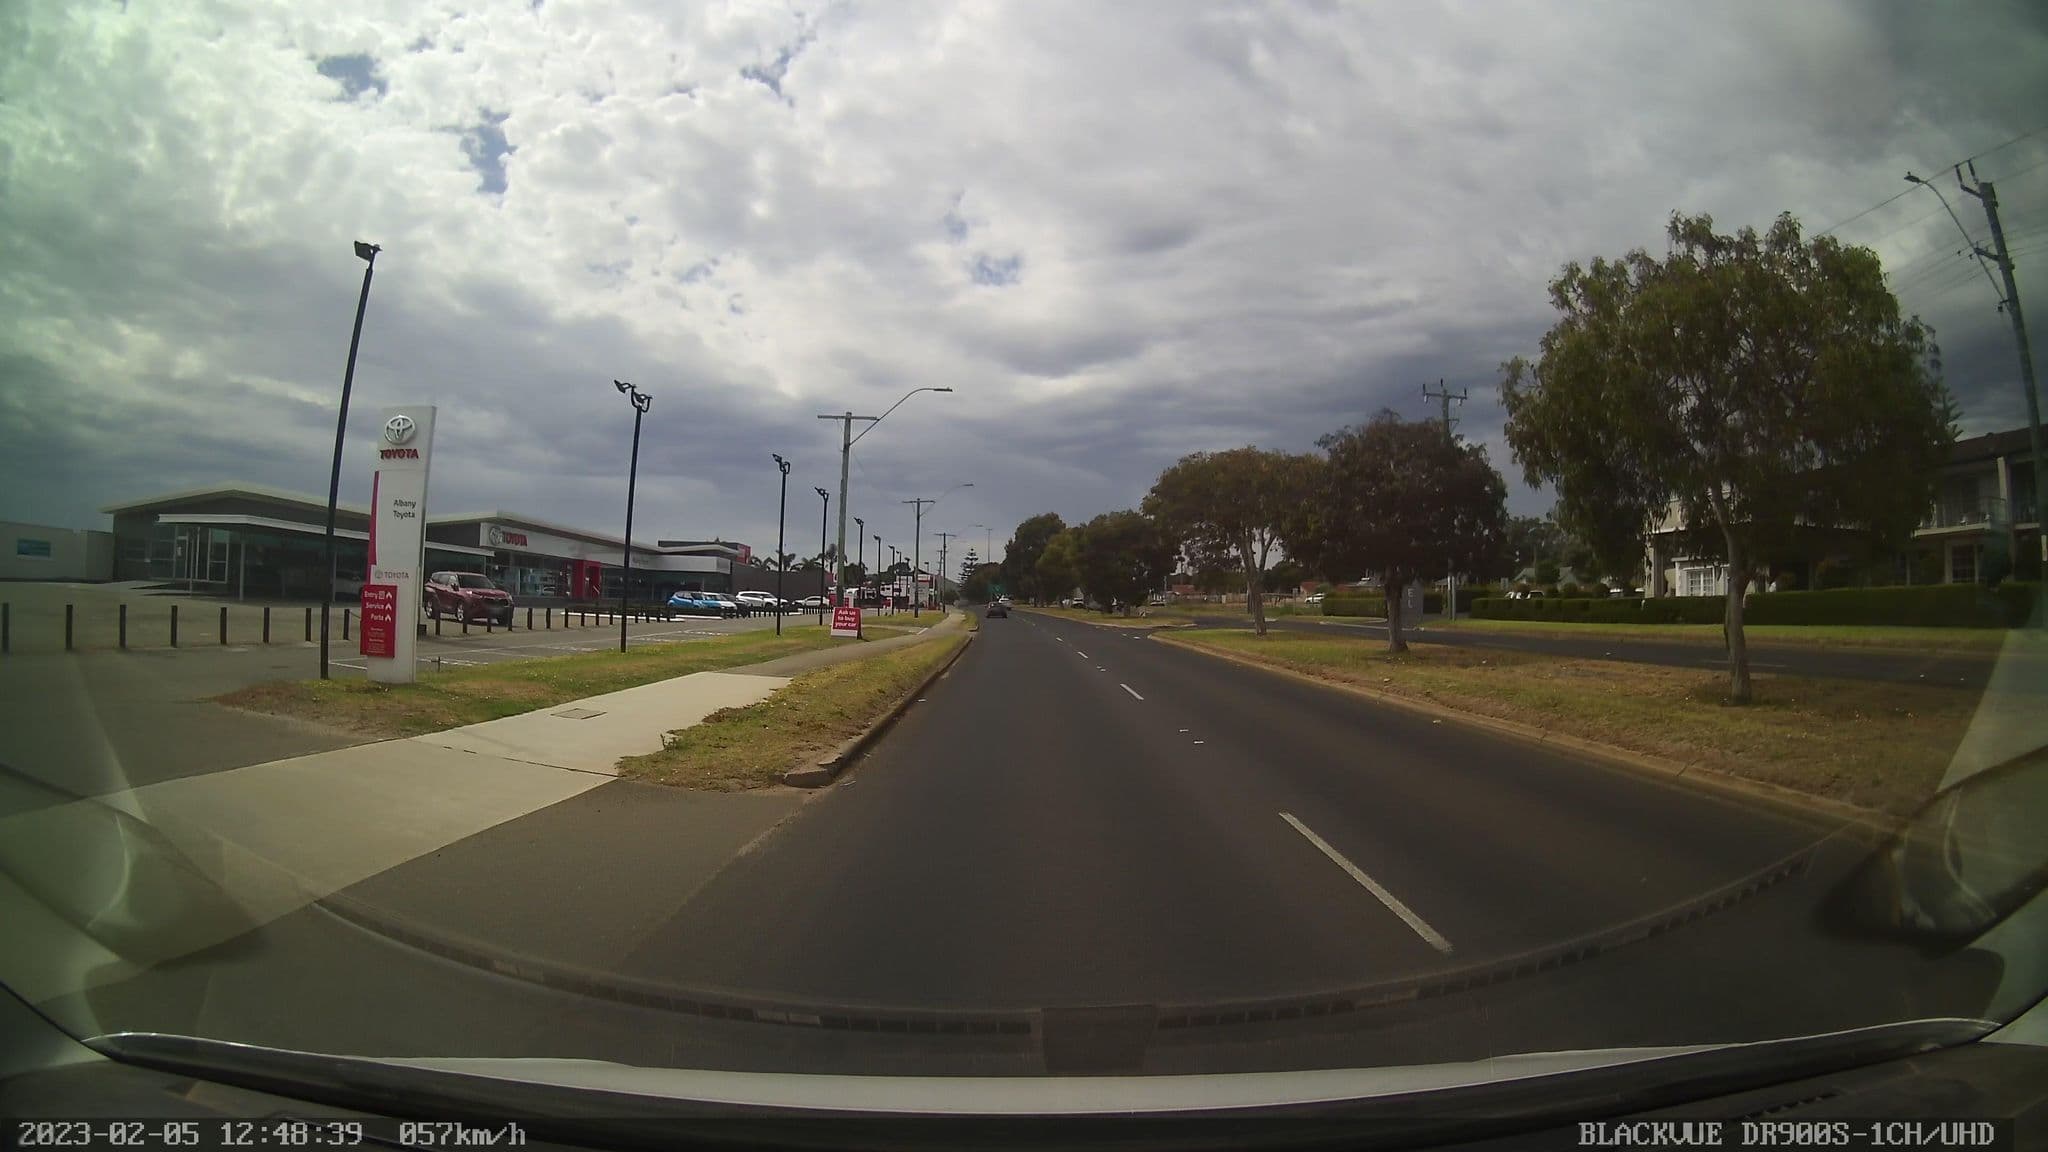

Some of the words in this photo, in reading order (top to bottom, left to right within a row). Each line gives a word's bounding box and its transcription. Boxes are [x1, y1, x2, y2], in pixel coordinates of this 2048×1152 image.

[380, 449, 419, 460] TOYOTA
[393, 499, 417, 508] Albany
[393, 510, 415, 520] Toyota
[502, 532, 528, 546] TOYOTA
[384, 571, 409, 579] TOYOTA
[365, 602, 384, 610] Service
[370, 613, 384, 621] Parts
